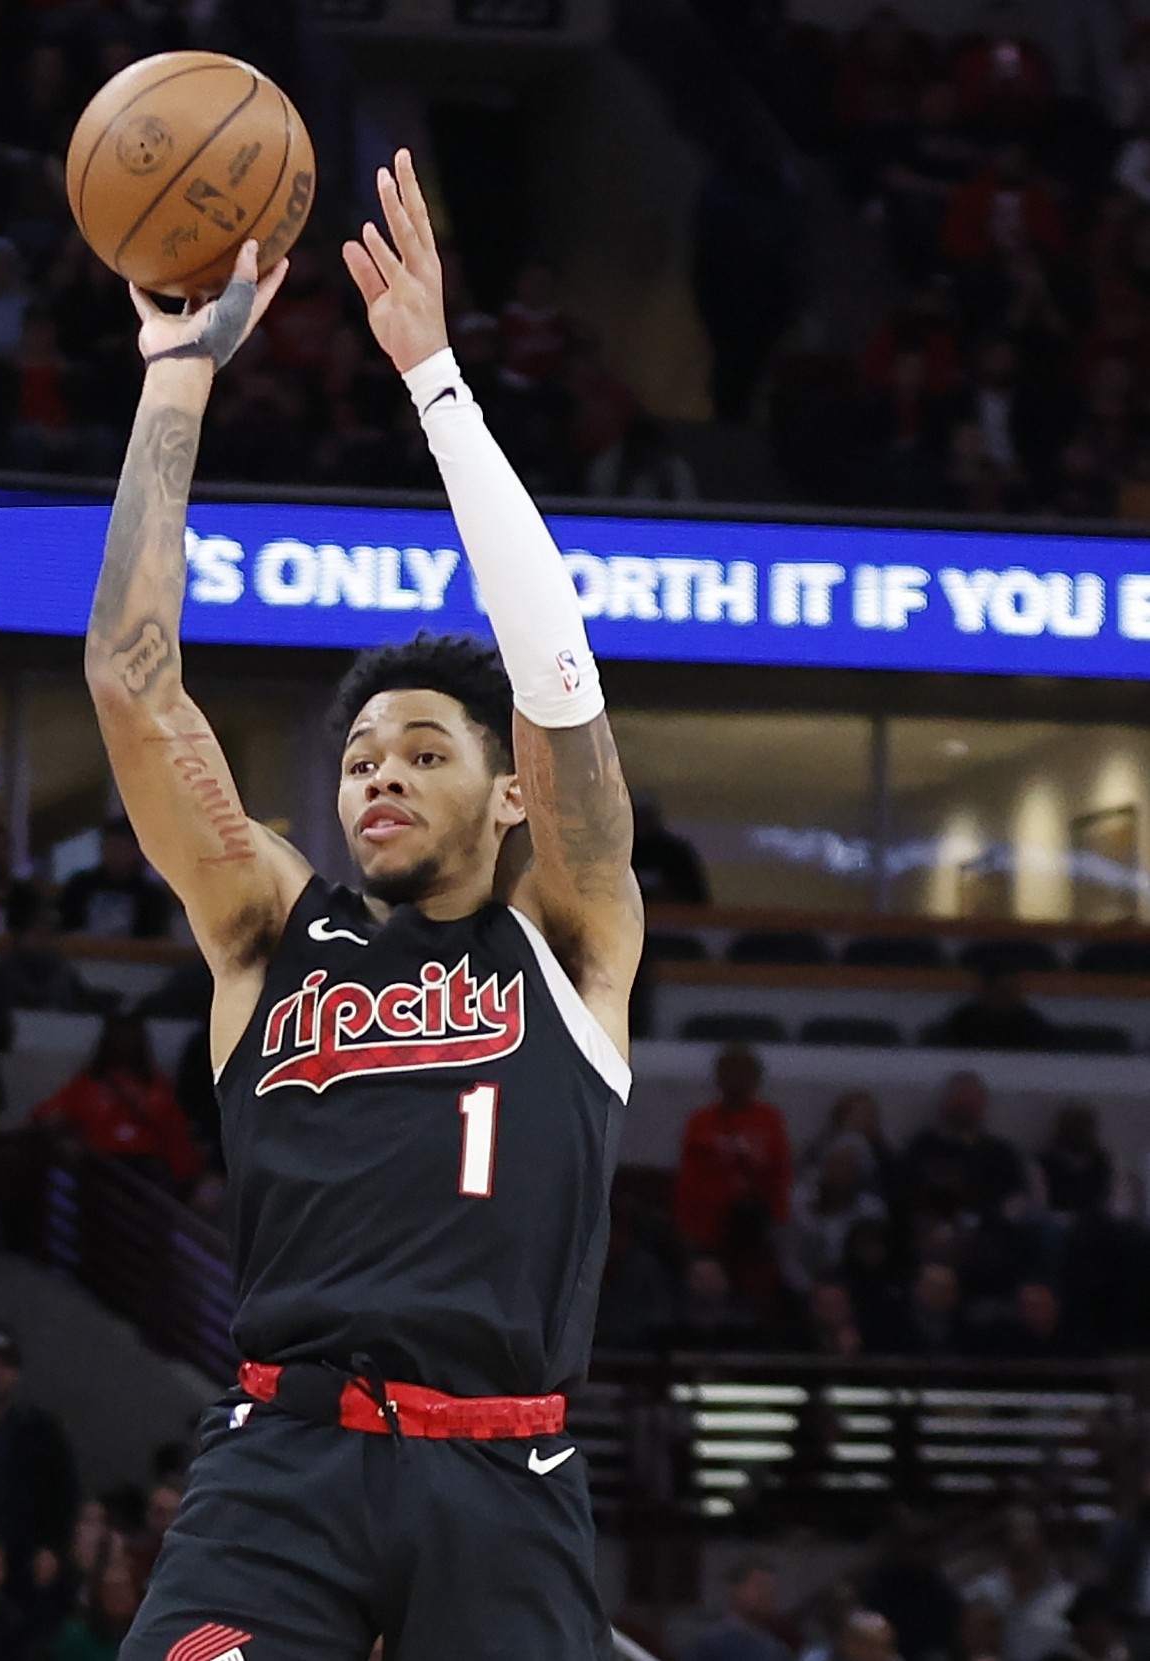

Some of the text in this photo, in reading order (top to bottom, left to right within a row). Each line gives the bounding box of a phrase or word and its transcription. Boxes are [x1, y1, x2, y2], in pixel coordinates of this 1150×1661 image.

[255, 538, 461, 610] ONLY
[468, 549, 759, 626] ORTH
[769, 559, 847, 627] IT
[853, 563, 933, 632] IF
[938, 565, 1107, 638] YOU
[458, 1081, 499, 1198] 1
